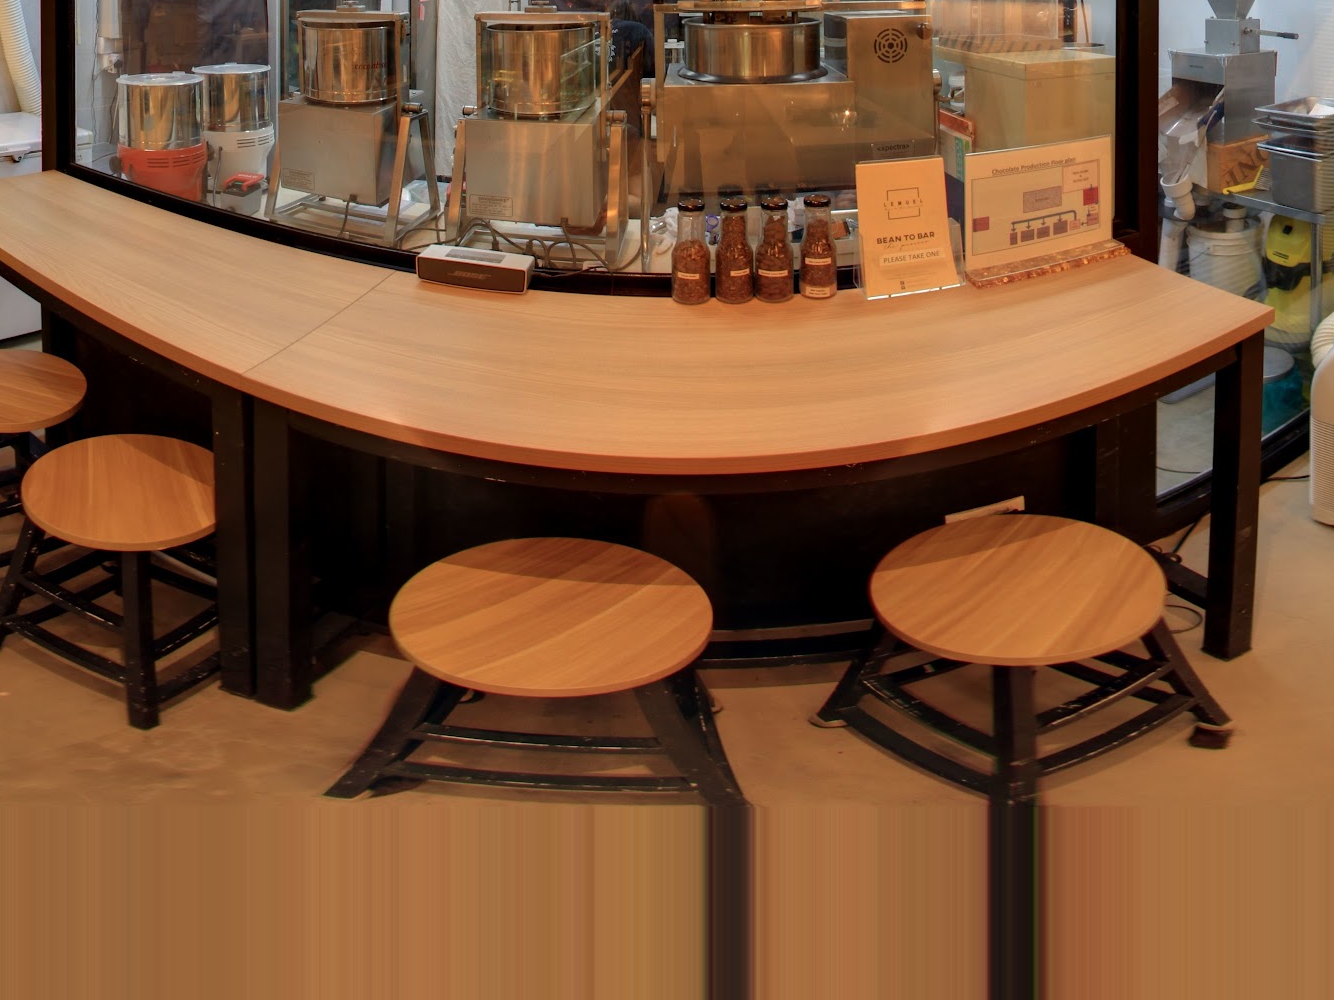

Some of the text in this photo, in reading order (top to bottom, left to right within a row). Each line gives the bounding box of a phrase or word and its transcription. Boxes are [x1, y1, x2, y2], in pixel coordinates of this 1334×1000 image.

[991, 166, 1020, 175] Chocolate
[1021, 161, 1050, 171] Production
[883, 199, 924, 208] LEMUEL
[876, 231, 935, 245] BEAN TO BAR
[883, 250, 940, 264] PLEASE TAKE ONE
